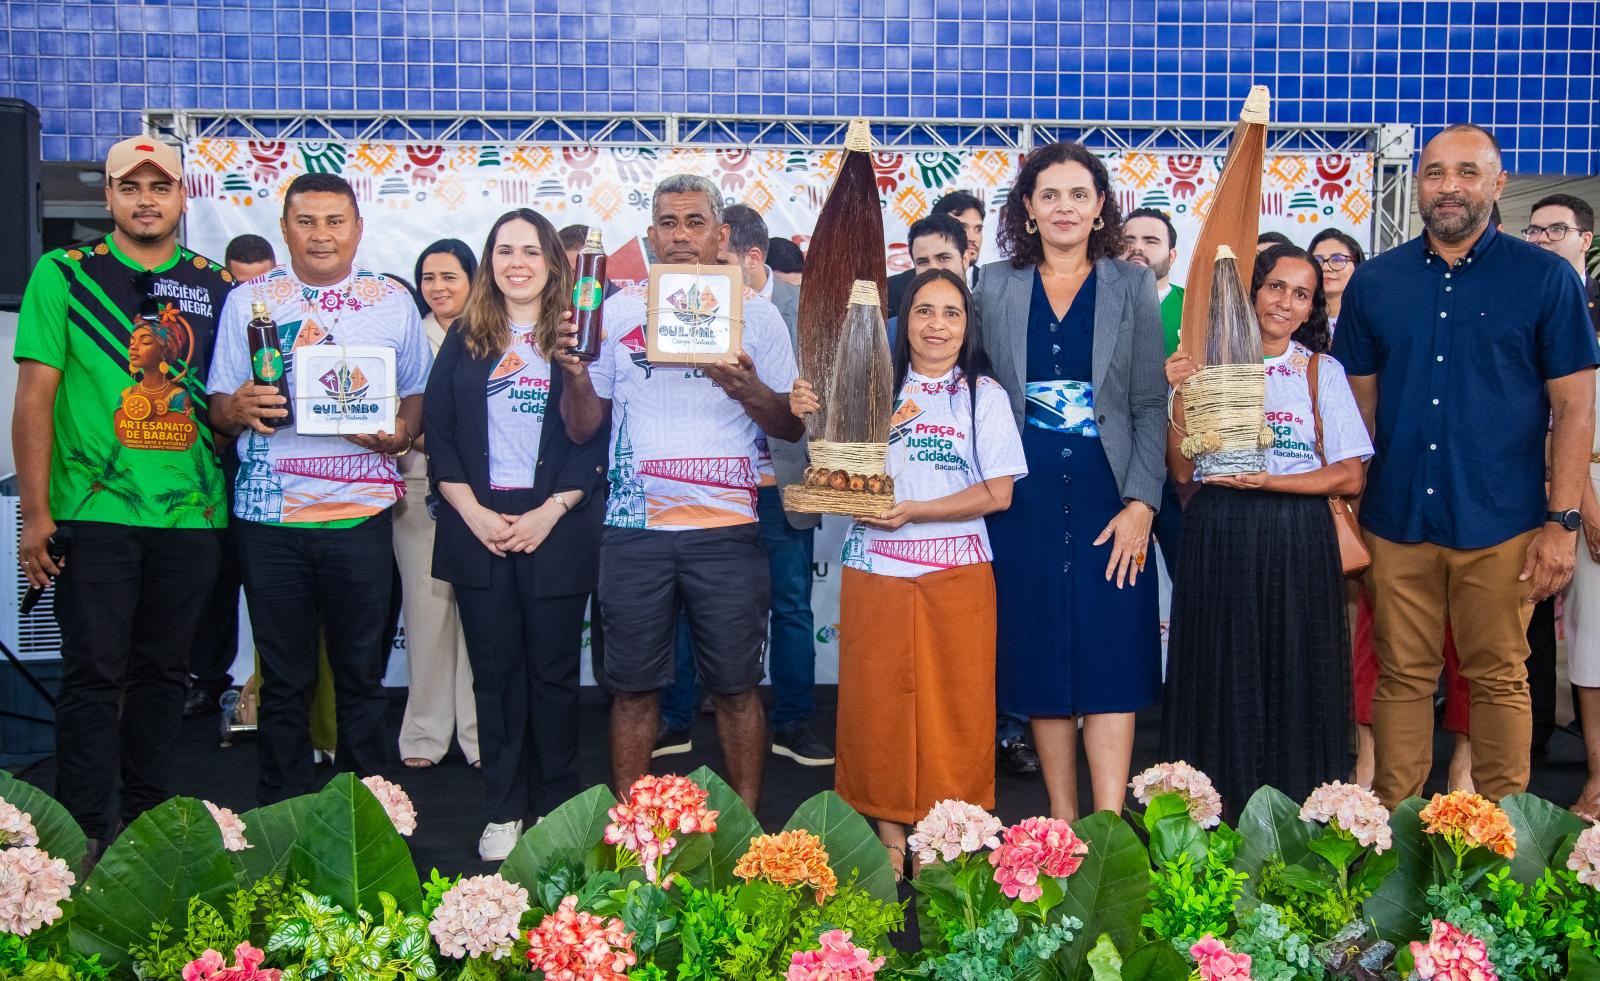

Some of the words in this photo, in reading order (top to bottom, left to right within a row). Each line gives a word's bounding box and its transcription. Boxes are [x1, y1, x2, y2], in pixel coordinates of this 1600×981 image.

[180, 299, 213, 318] NEGRA
[519, 376, 550, 391] Praç
[508, 388, 548, 405] Justiç
[312, 403, 379, 415] QUILOMBO
[511, 405, 518, 413] &
[1264, 411, 1294, 424] aça
[1294, 416, 1304, 425] de
[120, 420, 193, 433] ARTESANATO
[915, 423, 955, 437] Praça
[956, 431, 966, 440] de
[126, 430, 140, 439] DE
[906, 434, 953, 451] Justiça
[909, 454, 916, 462] &
